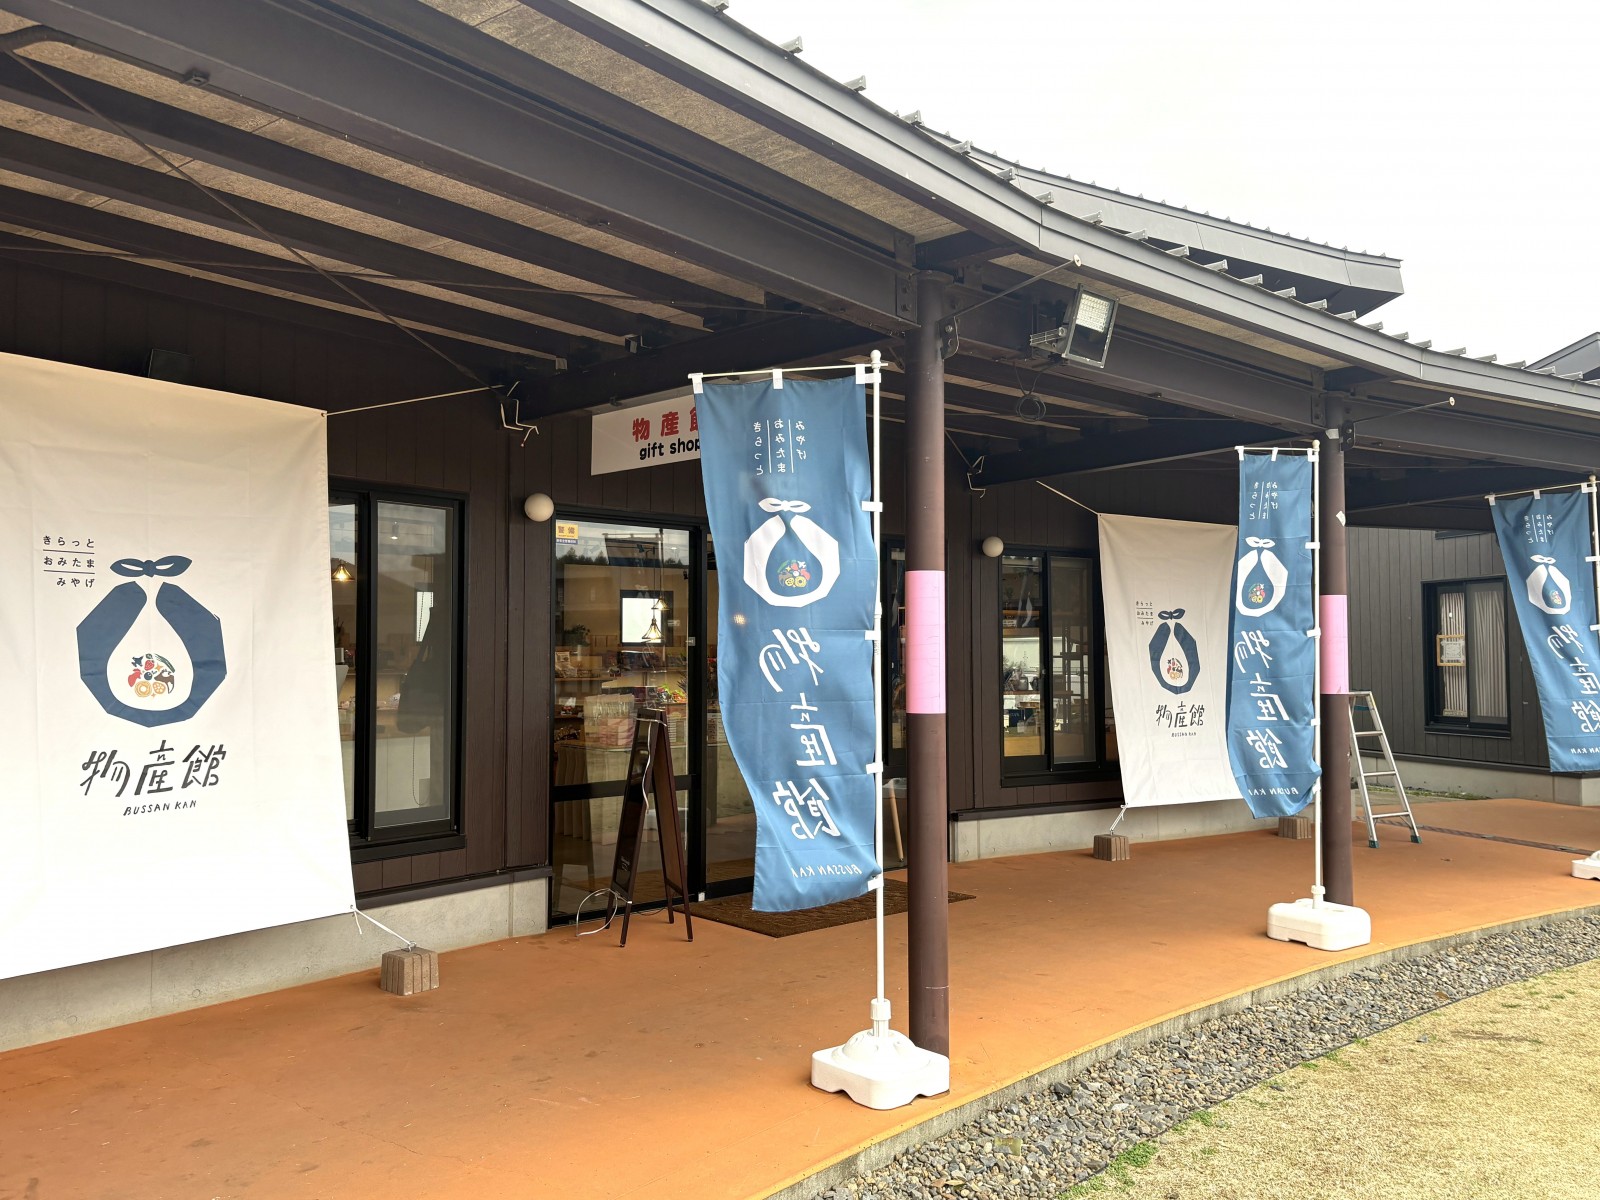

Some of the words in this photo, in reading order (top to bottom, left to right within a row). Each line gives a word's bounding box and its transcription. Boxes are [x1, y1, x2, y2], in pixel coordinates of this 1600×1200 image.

[639, 441, 664, 460] gift
[43, 535, 95, 549] きらっと
[43, 556, 95, 569] おみたま
[56, 576, 95, 588] みやげ
[1155, 700, 1205, 728] 物産館
[80, 740, 227, 797] 物産館
[123, 802, 171, 817] BUSSAN
[174, 800, 197, 810] KAN
